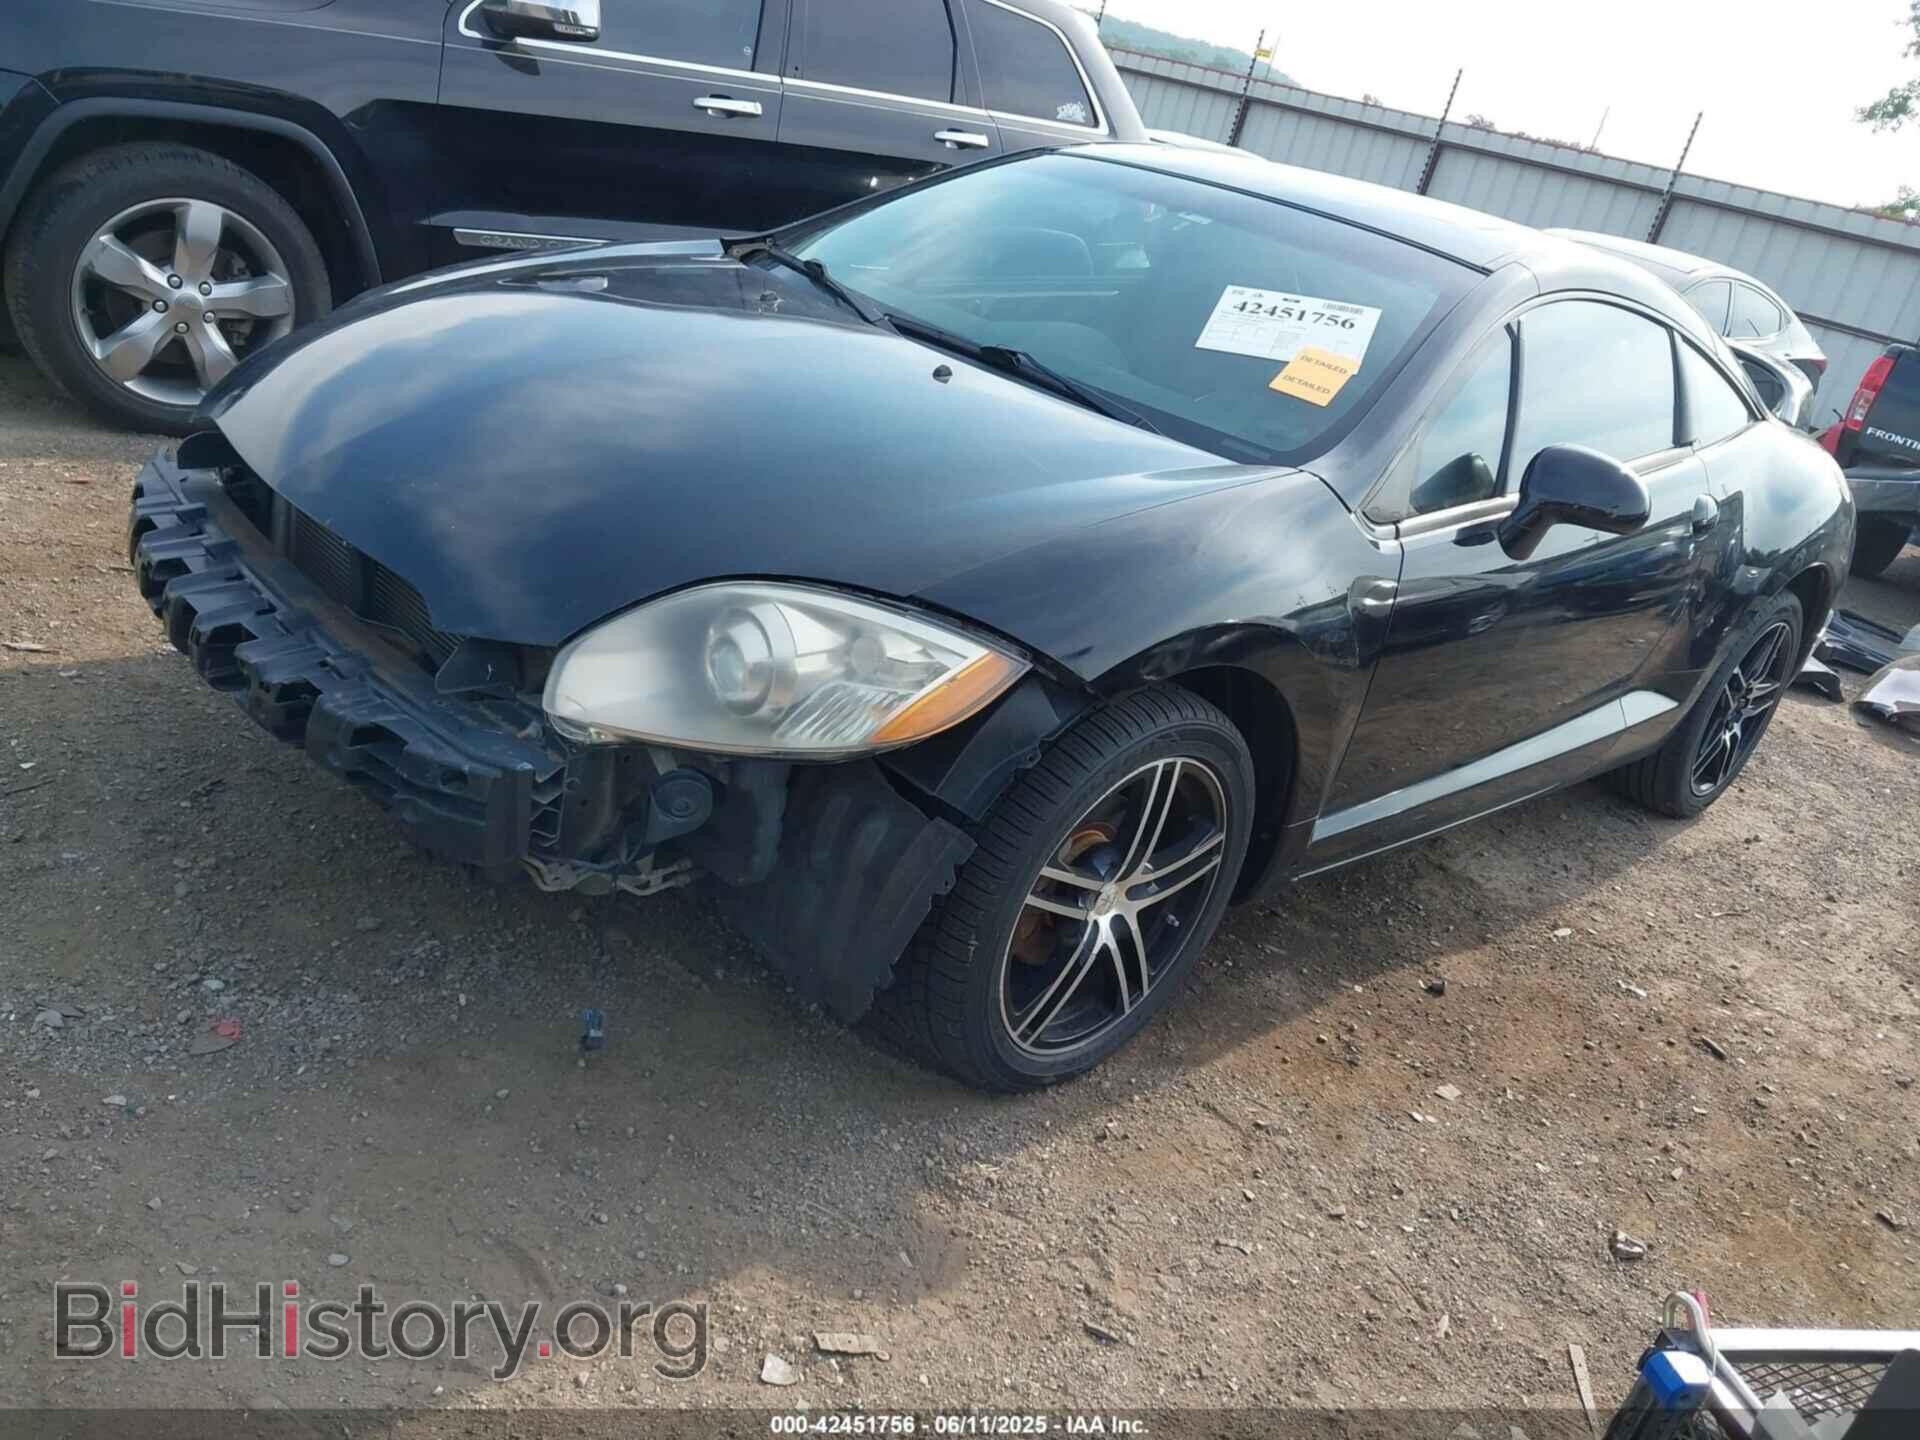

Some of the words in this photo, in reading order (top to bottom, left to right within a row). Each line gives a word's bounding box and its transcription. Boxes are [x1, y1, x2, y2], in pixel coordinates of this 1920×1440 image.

[480, 235, 541, 249] GRAND
[1233, 300, 1355, 329] 42451756
[1301, 355, 1348, 374] DETAILED
[1283, 374, 1331, 394] DETAILED
